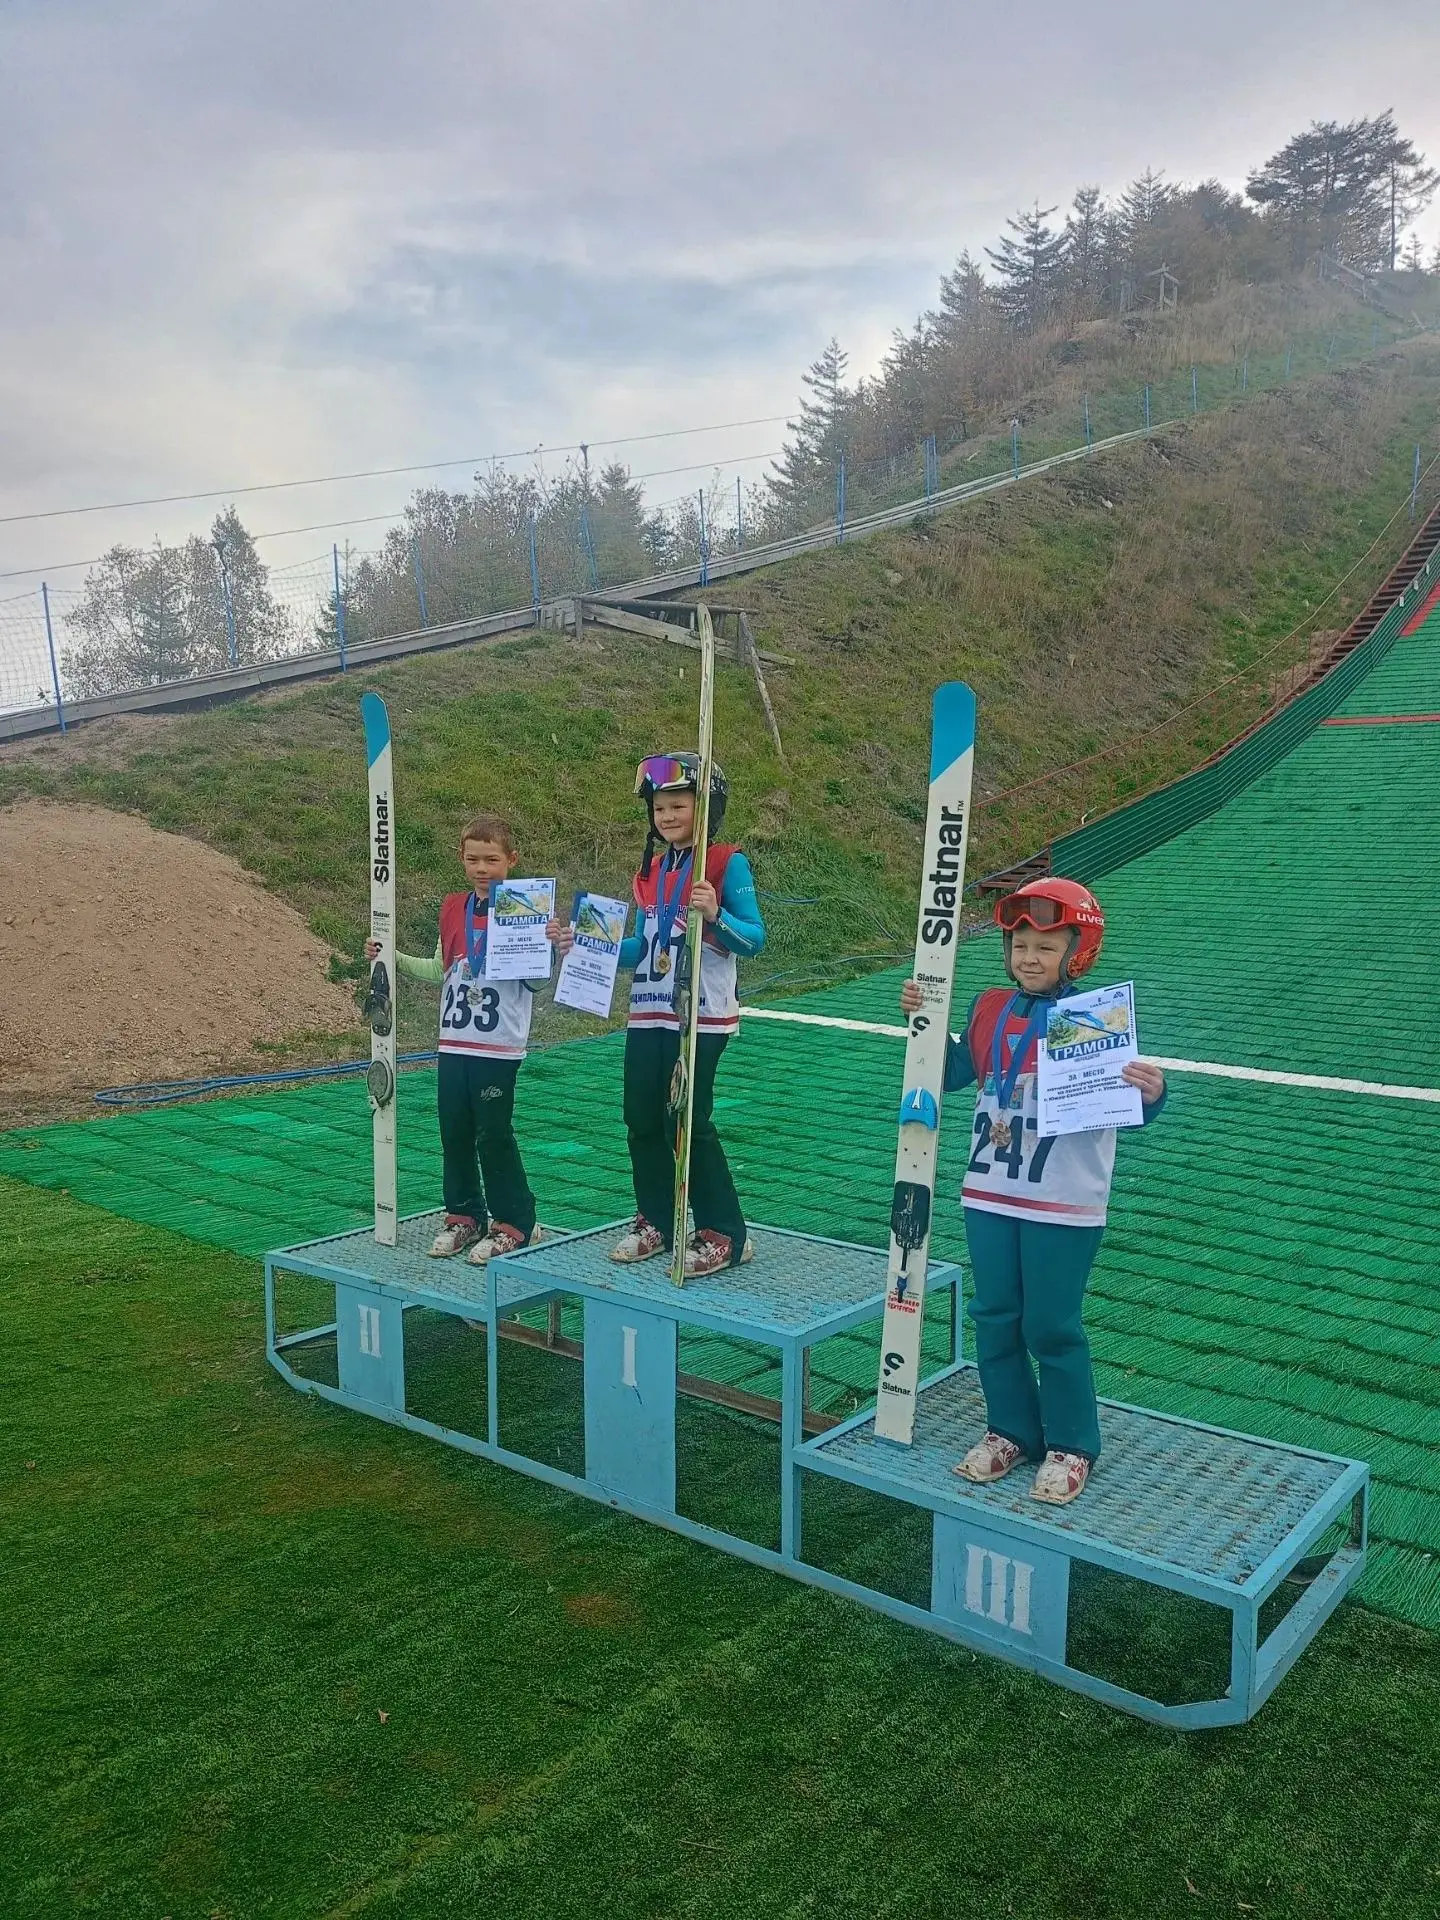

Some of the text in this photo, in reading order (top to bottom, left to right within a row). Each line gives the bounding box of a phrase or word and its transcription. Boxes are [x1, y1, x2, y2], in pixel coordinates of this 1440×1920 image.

[374, 795, 389, 883] Slatnar
[922, 806, 963, 947] Slatnar
[499, 914, 548, 926] ГРАМОТА
[576, 934, 617, 955] ГРАМОТА
[1076, 912, 1104, 926] uve
[442, 983, 500, 1032] 233
[1054, 1034, 1129, 1061] ГРАМОТА
[1083, 1068, 1105, 1078] МЕСТО
[968, 1111, 1057, 1183] 247
[357, 1303, 382, 1358] II
[622, 1326, 638, 1387] I
[964, 1543, 1035, 1635] III
